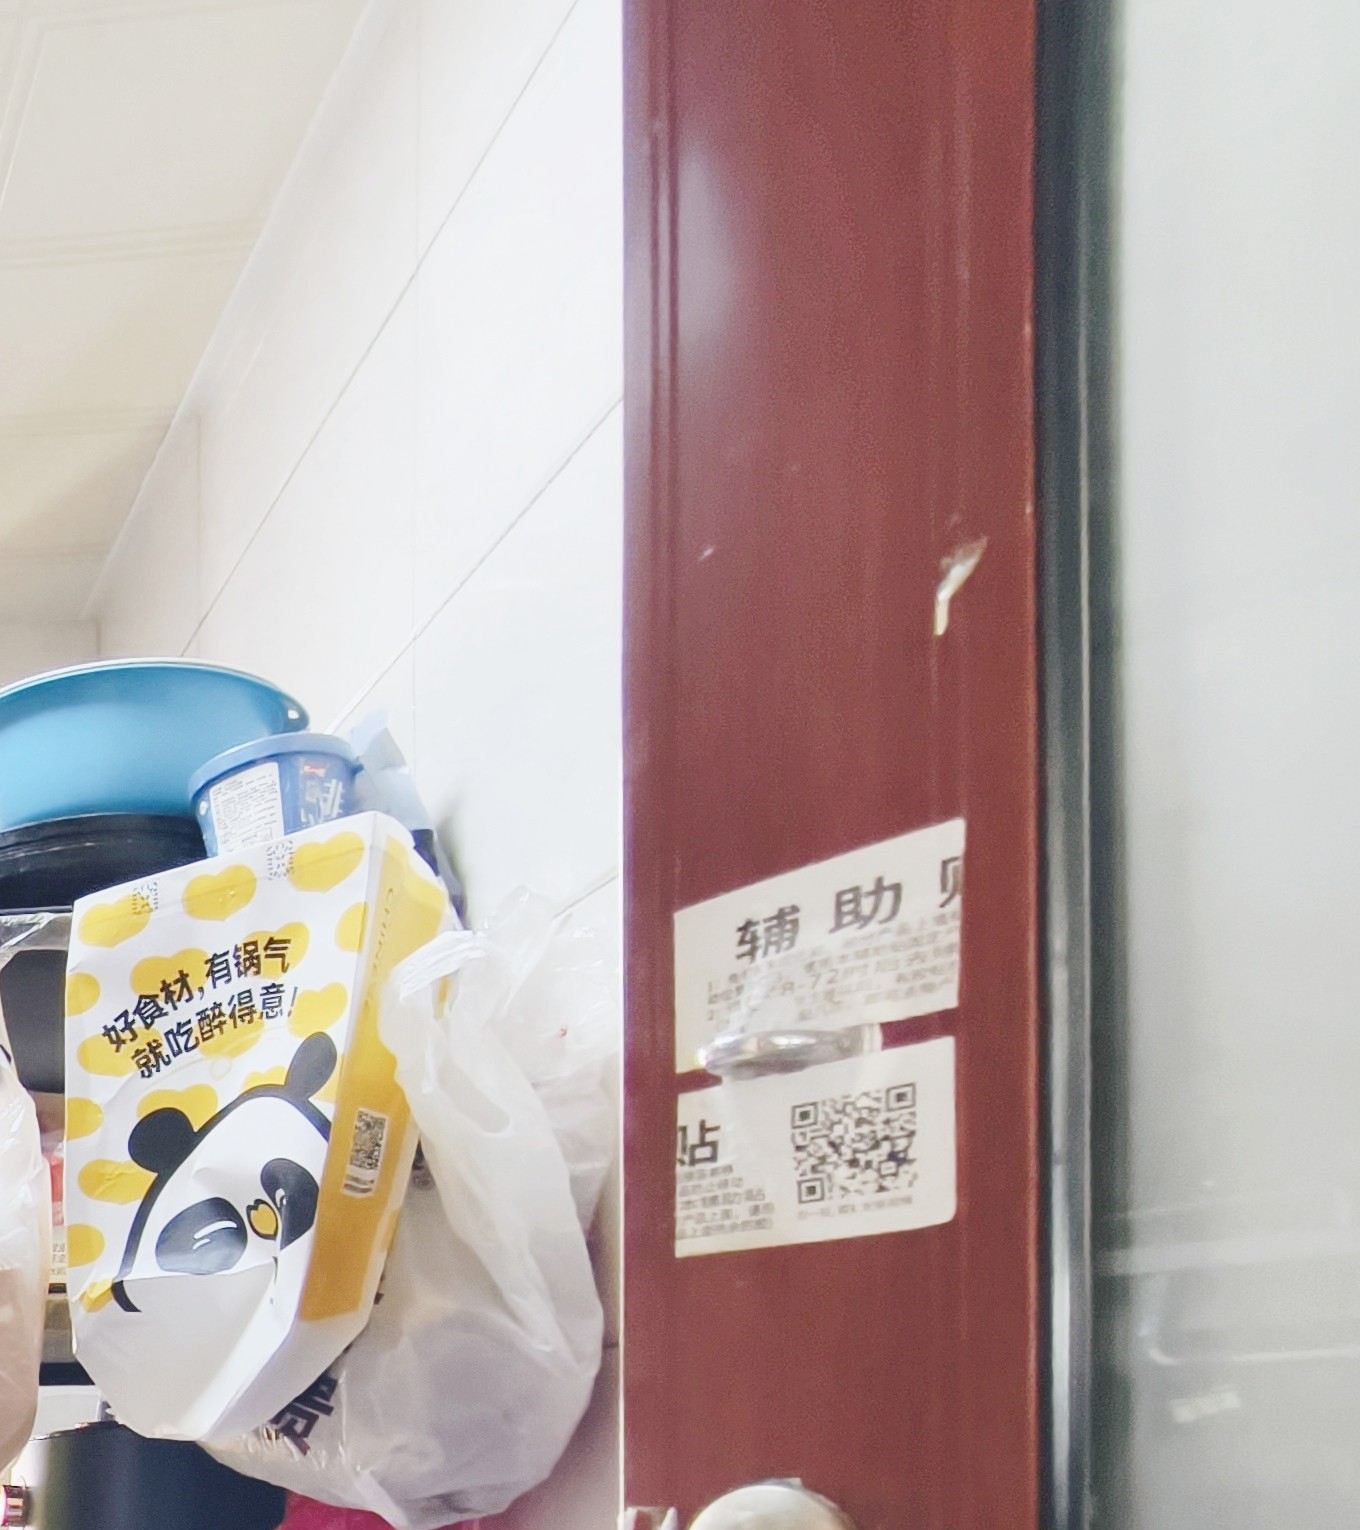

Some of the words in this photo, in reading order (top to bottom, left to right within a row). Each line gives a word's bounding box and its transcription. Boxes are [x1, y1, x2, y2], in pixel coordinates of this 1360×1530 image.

[101, 936, 292, 1053] 好食材，有锅气
